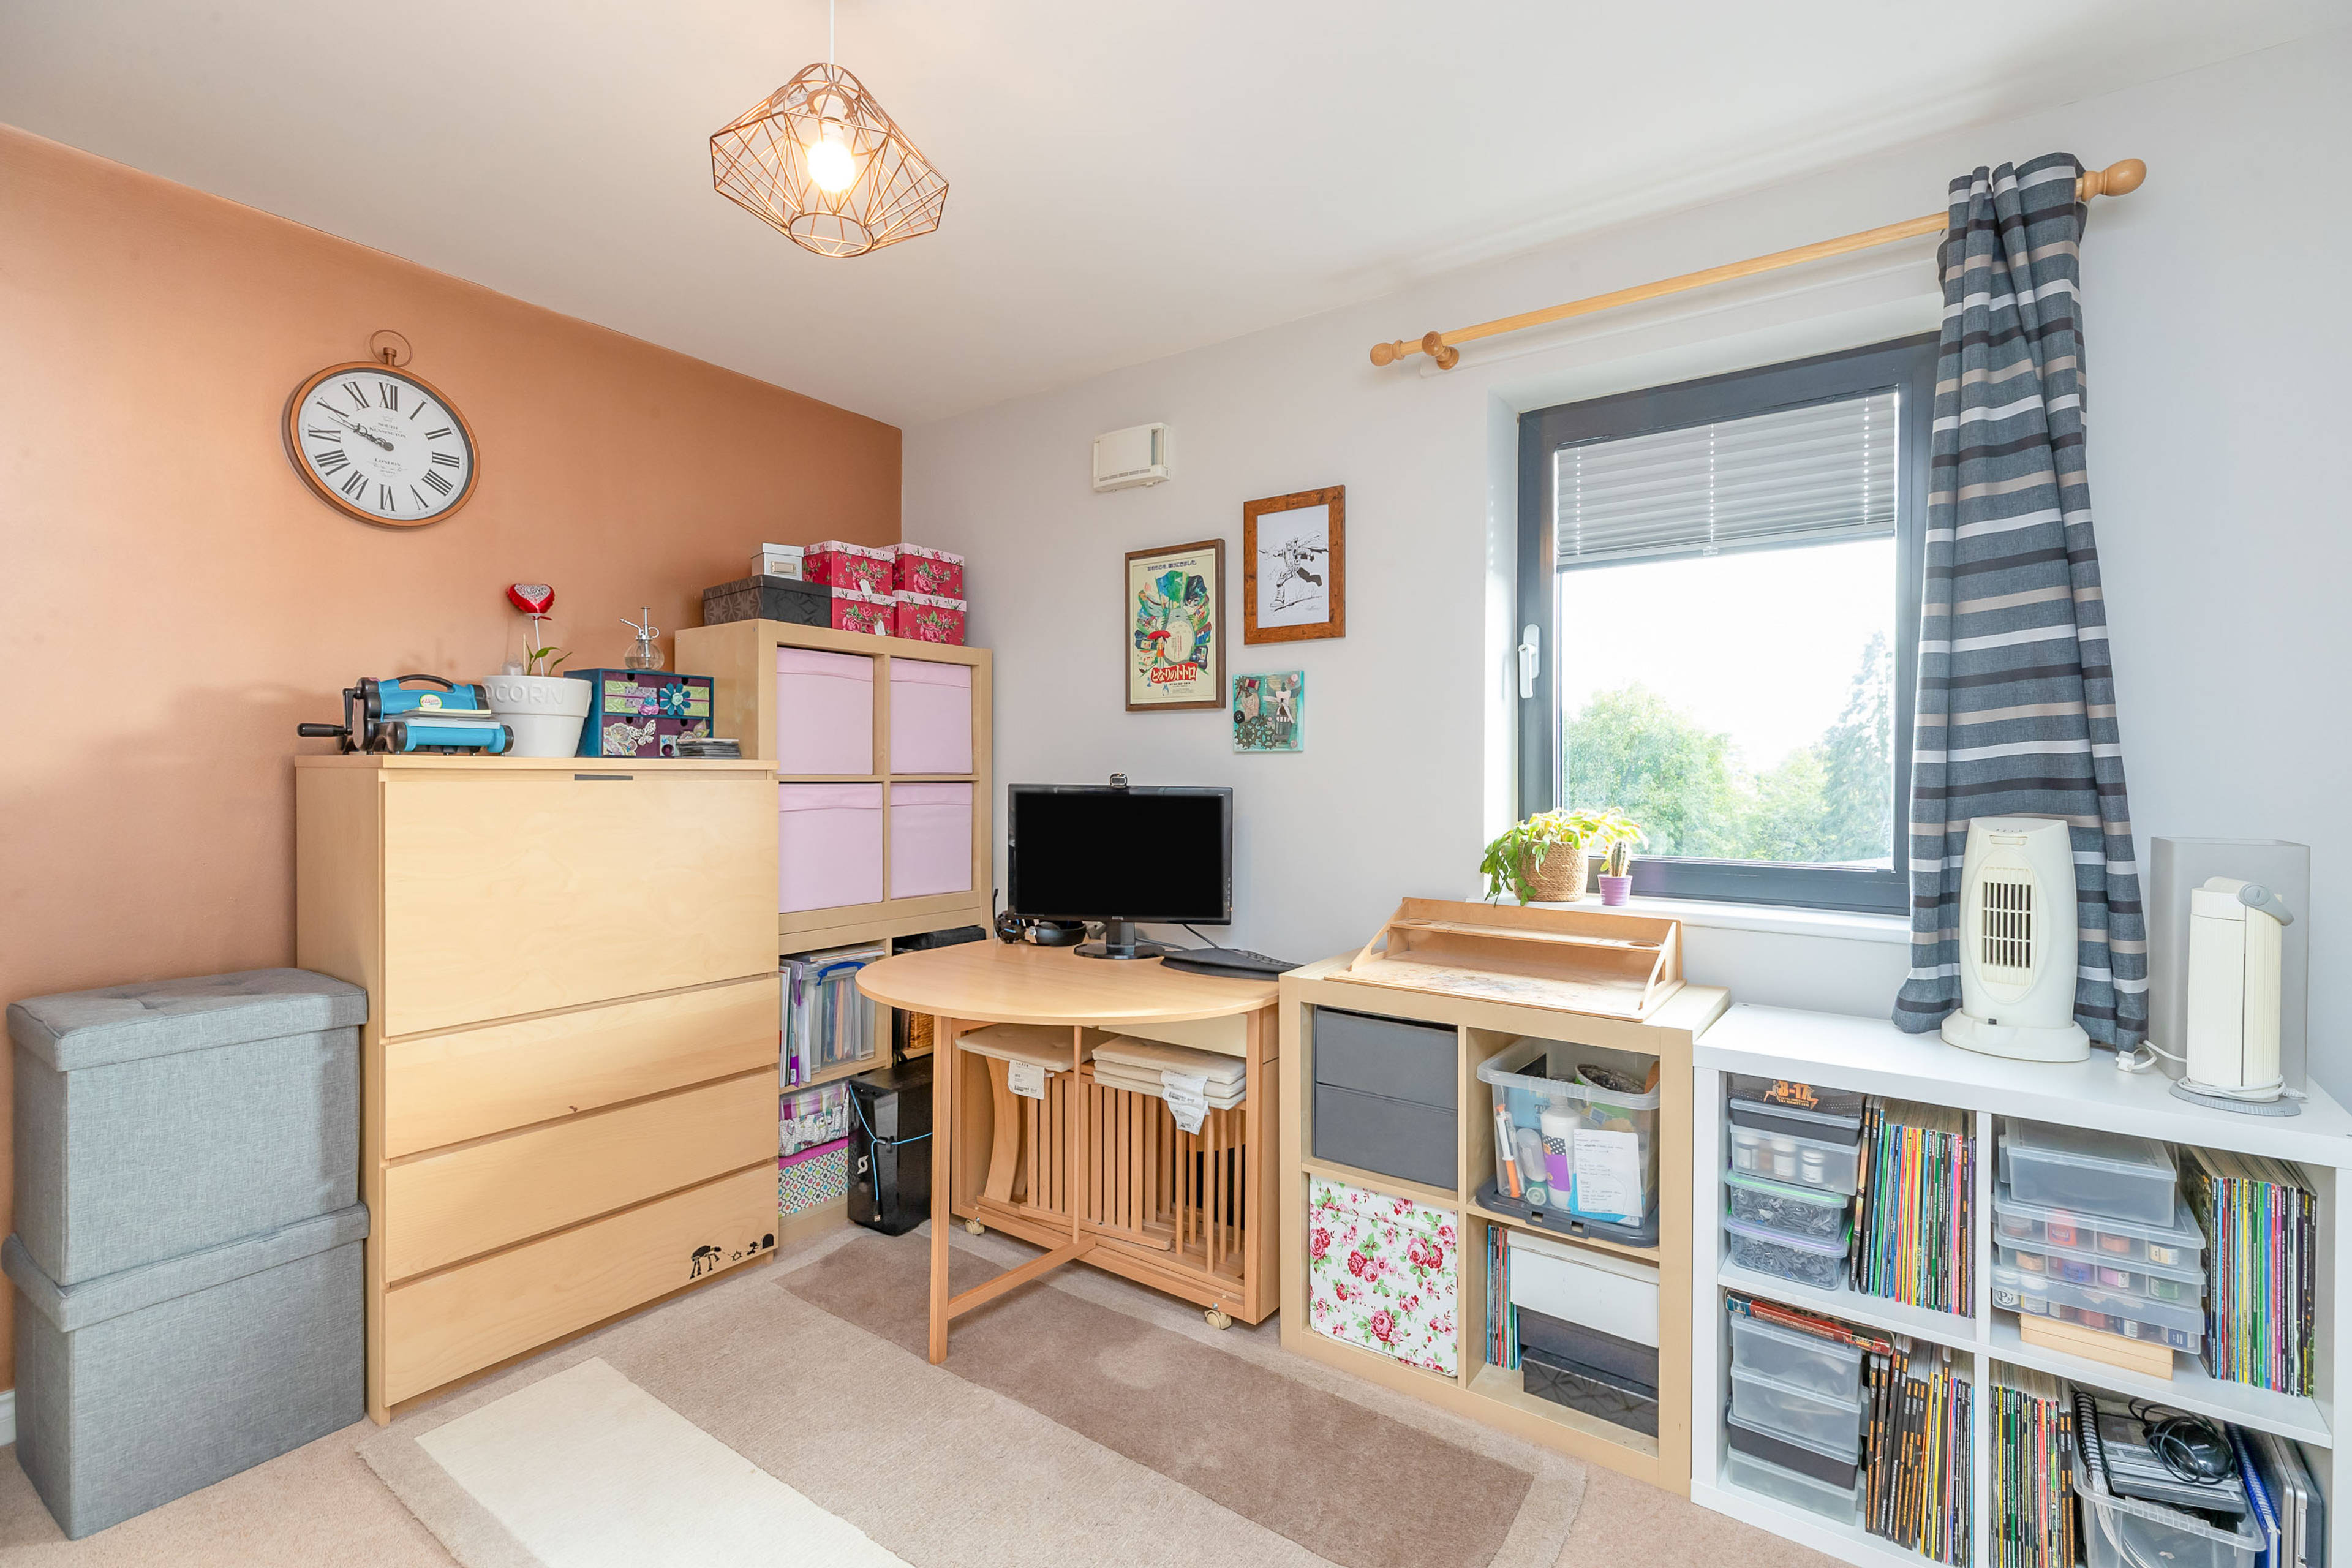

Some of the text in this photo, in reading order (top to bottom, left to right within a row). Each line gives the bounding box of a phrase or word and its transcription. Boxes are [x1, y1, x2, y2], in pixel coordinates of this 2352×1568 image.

[341, 381, 371, 411] XI
[378, 382, 399, 412] XII
[409, 399, 428, 421] I
[308, 424, 342, 443] IX
[424, 426, 453, 440] II
[314, 450, 351, 477] VIII
[374, 458, 401, 467] LONDON
[432, 451, 460, 469] III
[340, 470, 369, 500] VII
[421, 469, 453, 497] IIII
[379, 484, 396, 511] VI
[410, 484, 429, 511] V
[1152, 664, 1196, 682] となりのトトロ
